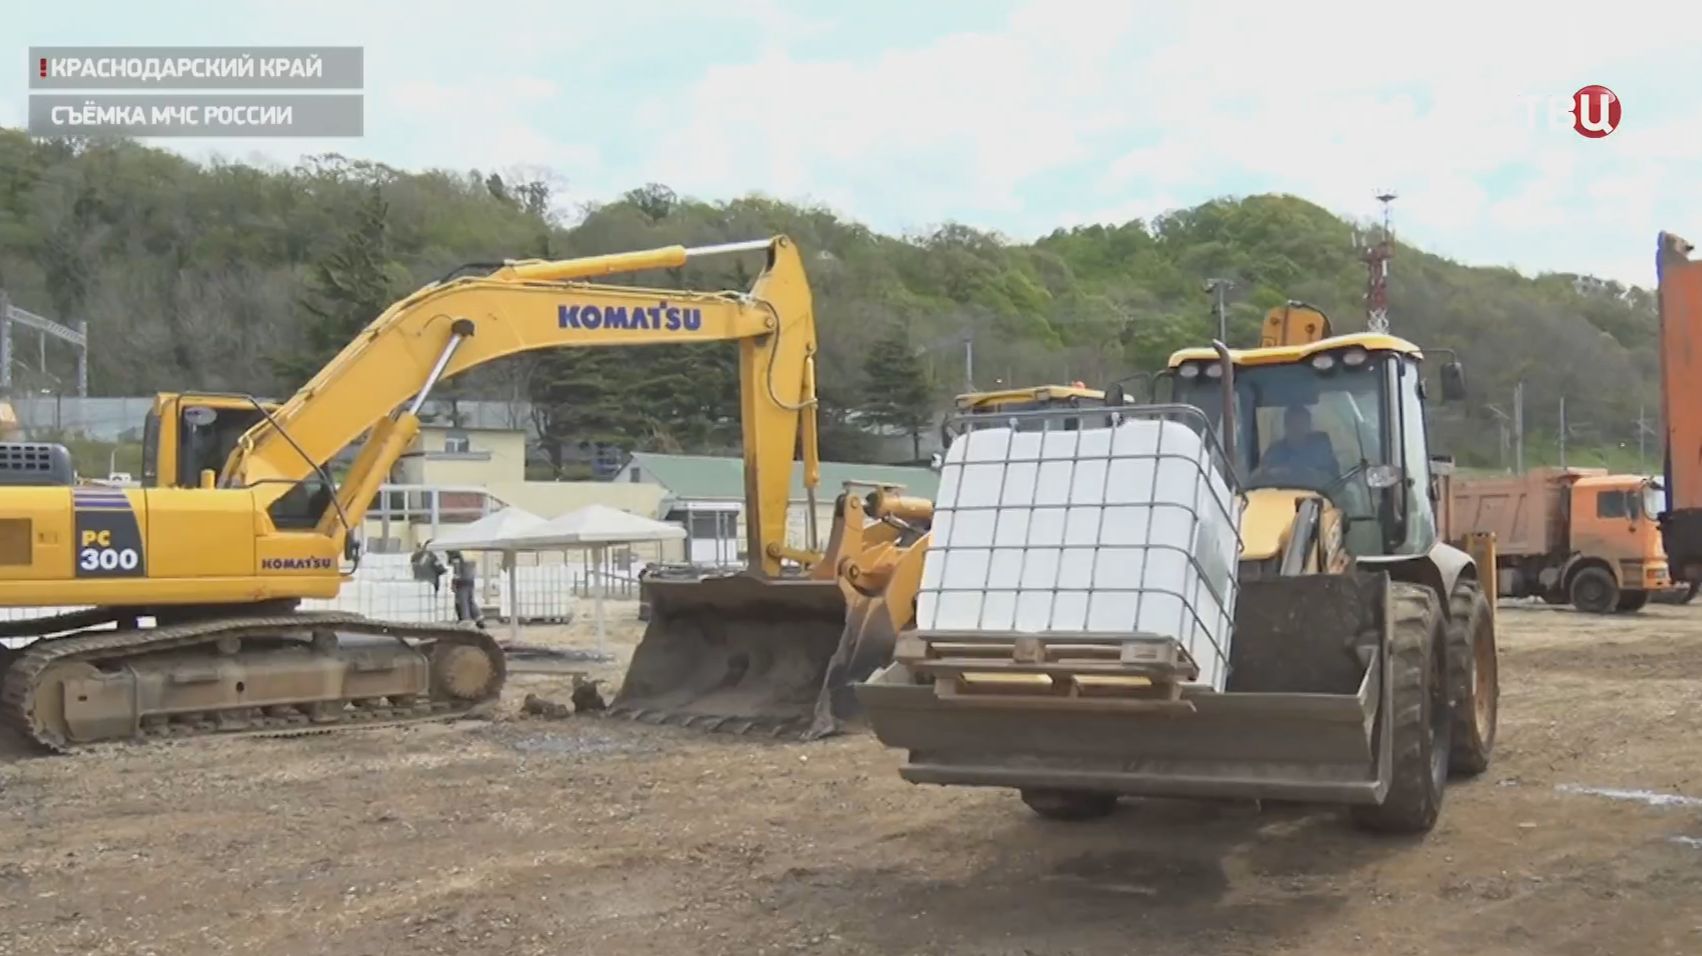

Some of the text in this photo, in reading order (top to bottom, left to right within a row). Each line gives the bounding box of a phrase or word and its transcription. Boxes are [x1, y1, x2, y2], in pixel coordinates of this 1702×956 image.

[558, 302, 701, 330] KOMATSU
[82, 530, 110, 547] PC
[81, 549, 138, 570] 300
[261, 555, 331, 570] KOMATSU
